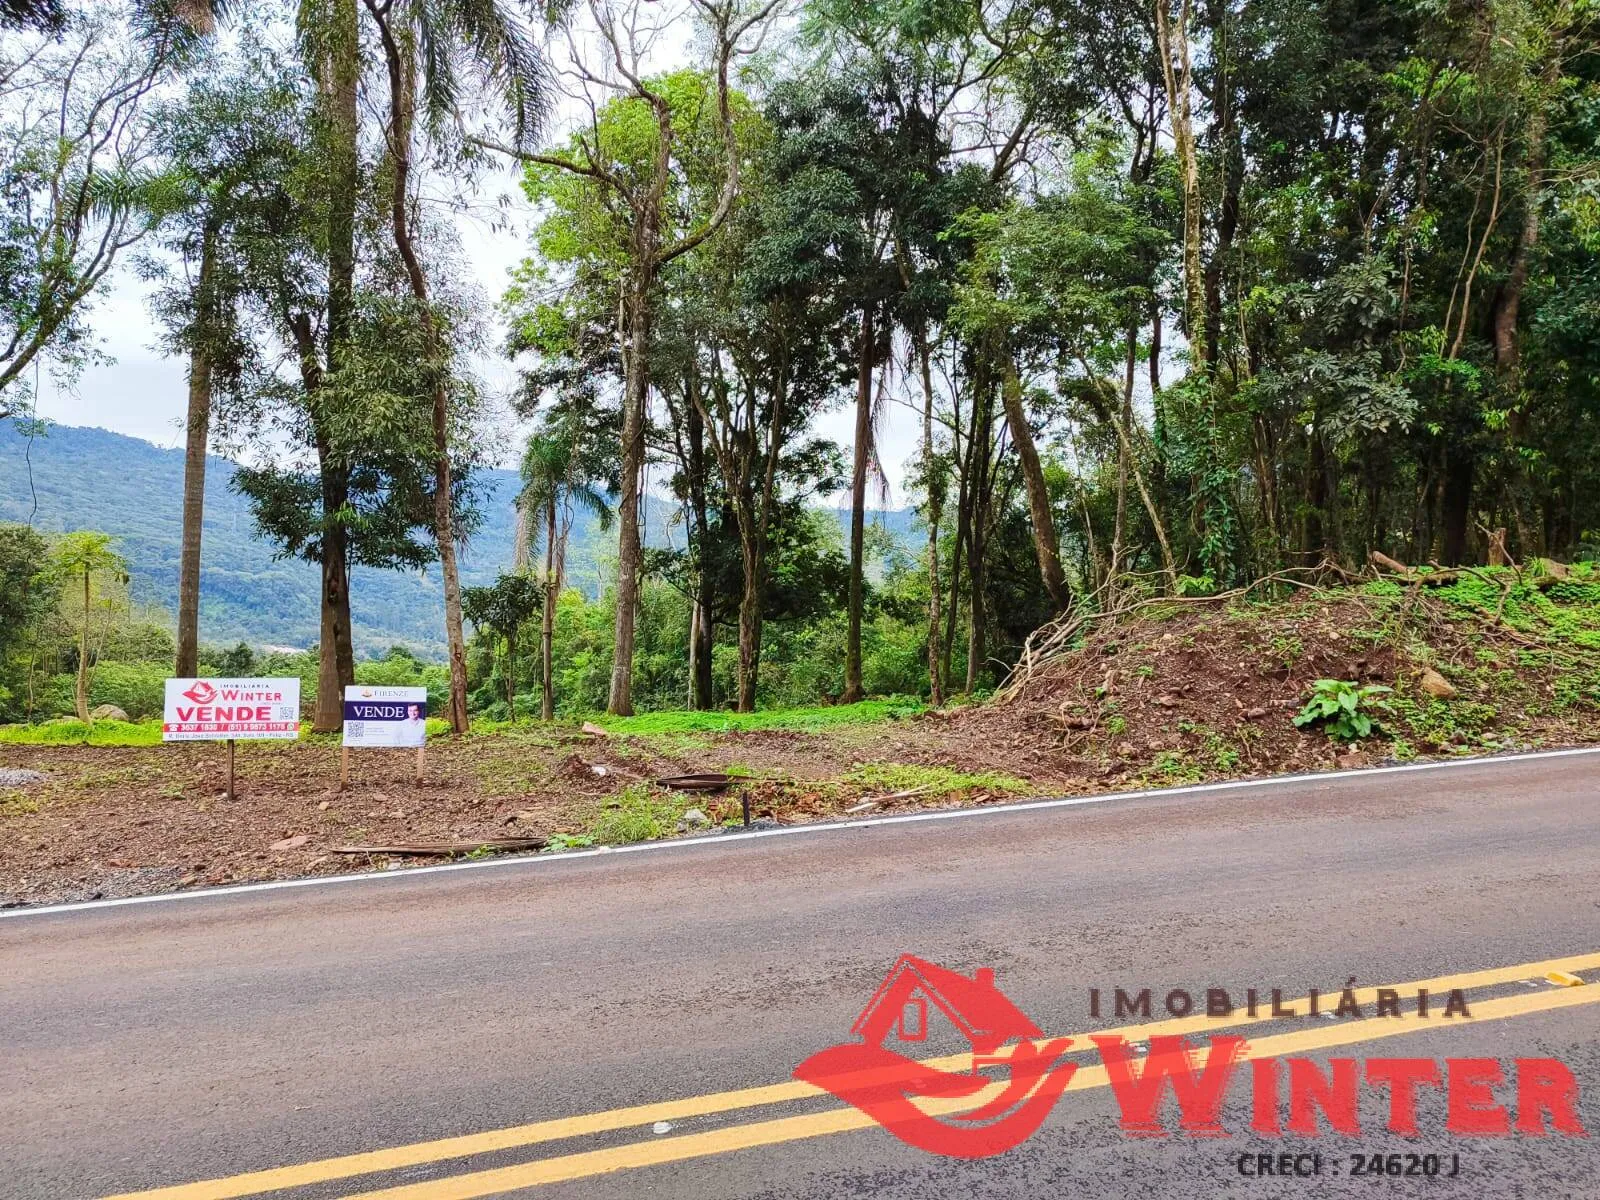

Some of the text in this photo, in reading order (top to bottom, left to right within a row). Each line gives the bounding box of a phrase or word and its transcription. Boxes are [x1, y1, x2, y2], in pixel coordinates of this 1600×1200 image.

[221, 689, 282, 701] WINTER
[176, 706, 272, 722] VENDE
[353, 706, 405, 718] VENDE
